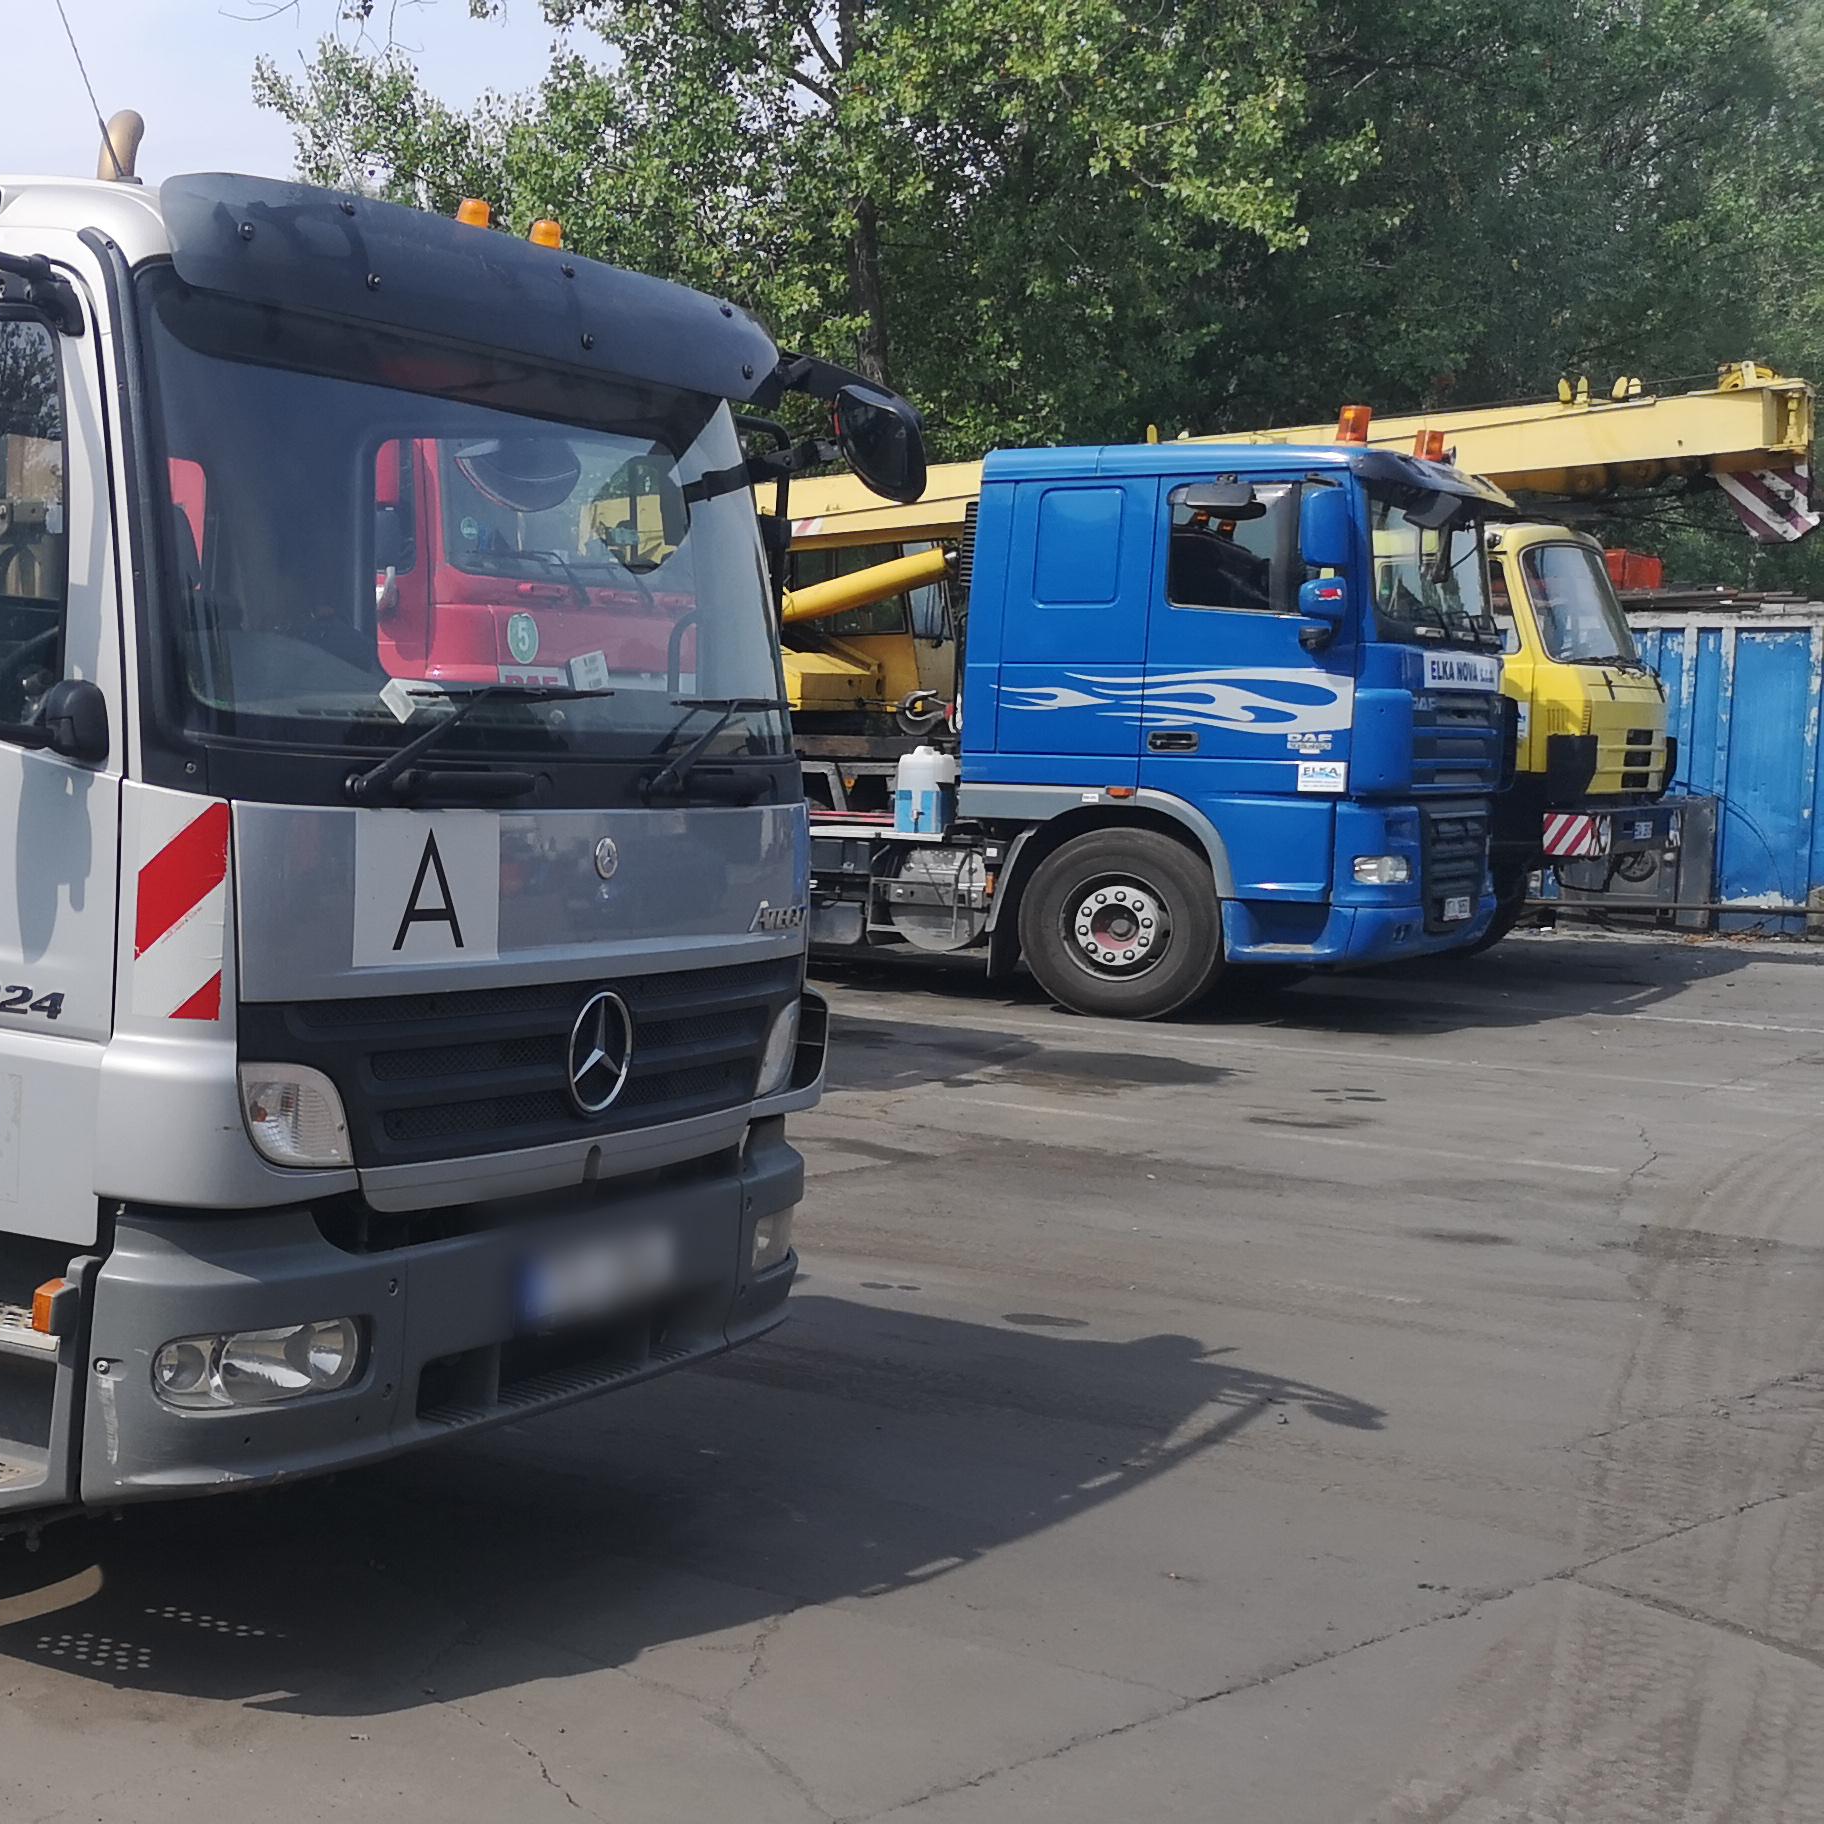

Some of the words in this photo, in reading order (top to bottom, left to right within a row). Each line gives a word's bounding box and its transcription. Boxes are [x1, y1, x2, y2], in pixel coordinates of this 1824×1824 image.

[517, 620, 529, 651] 5
[1430, 660, 1455, 681] ELKA
[1457, 661, 1478, 682] NOVA
[1287, 733, 1332, 742] DAF
[392, 827, 464, 950] A
